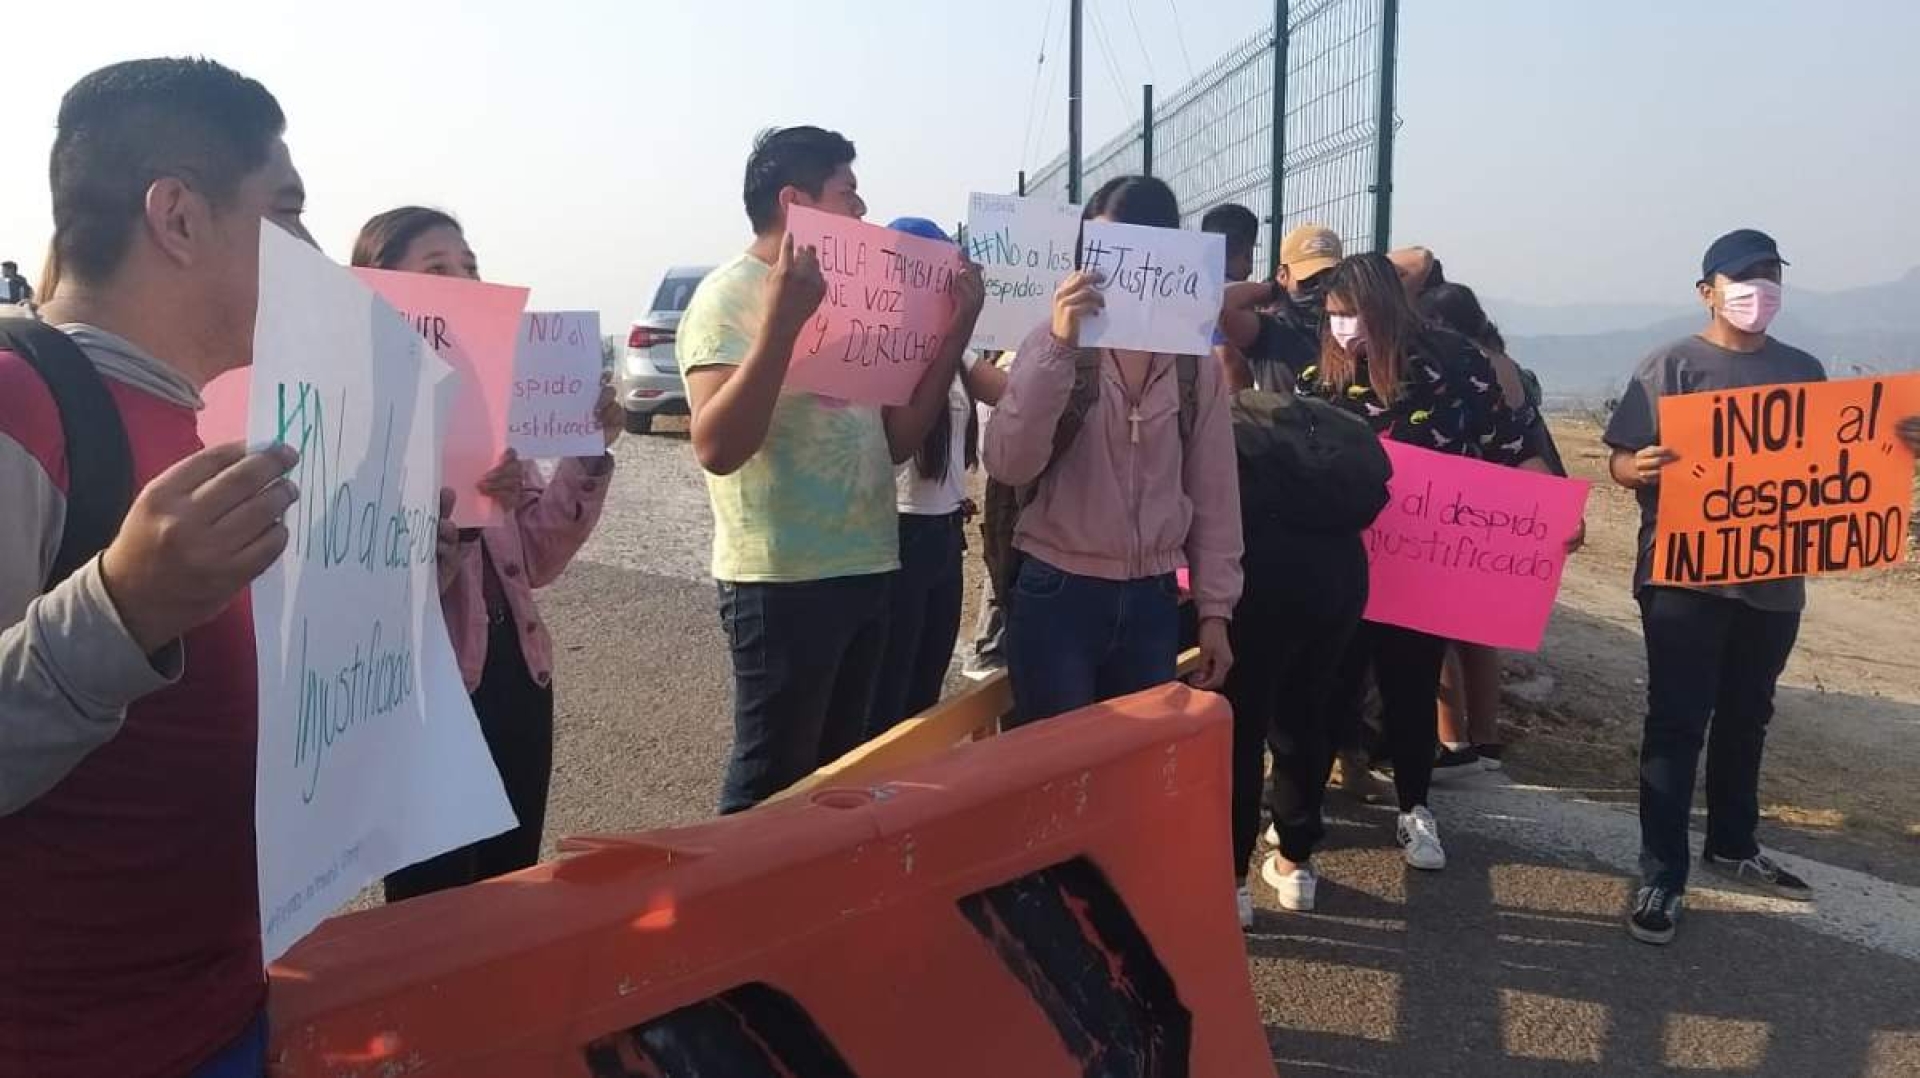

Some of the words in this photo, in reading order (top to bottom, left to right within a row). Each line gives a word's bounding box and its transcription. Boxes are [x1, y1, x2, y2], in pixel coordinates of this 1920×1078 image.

[821, 235, 868, 279] ELLA
[1046, 239, 1073, 271] los
[1084, 239, 1199, 302] #Justicia
[865, 285, 906, 313] VOZ
[983, 273, 1044, 304] espidos
[842, 318, 940, 367] DERECHO
[512, 374, 583, 402] spido
[1712, 387, 1806, 458] ¡NO!
[1836, 381, 1883, 444] al
[1402, 480, 1433, 519] al
[1439, 490, 1548, 542] despido
[1664, 506, 1902, 583] INJUSTIFICADO
